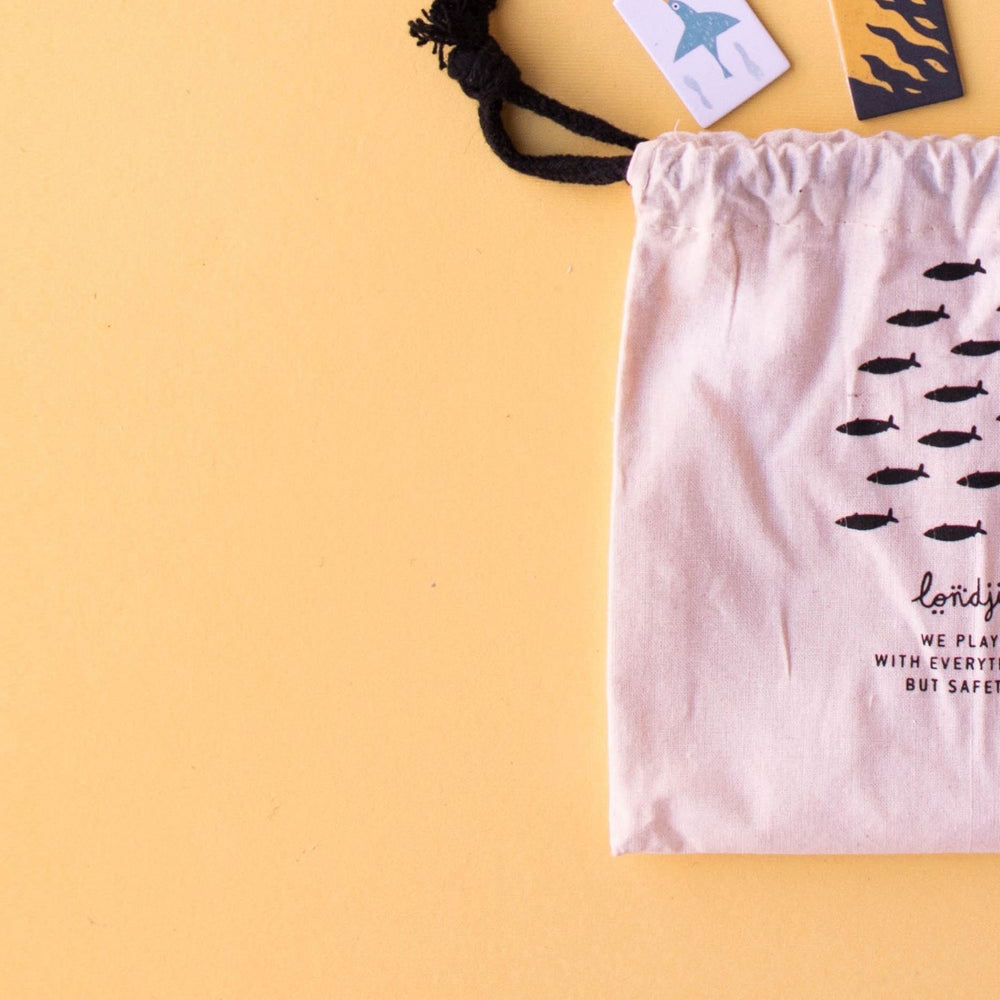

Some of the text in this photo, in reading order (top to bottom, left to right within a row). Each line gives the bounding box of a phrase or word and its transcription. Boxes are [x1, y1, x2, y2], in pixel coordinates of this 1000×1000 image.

[921, 634, 999, 648] WE PLAY
[875, 654, 920, 668] WITH
[906, 678, 938, 691] BUT
